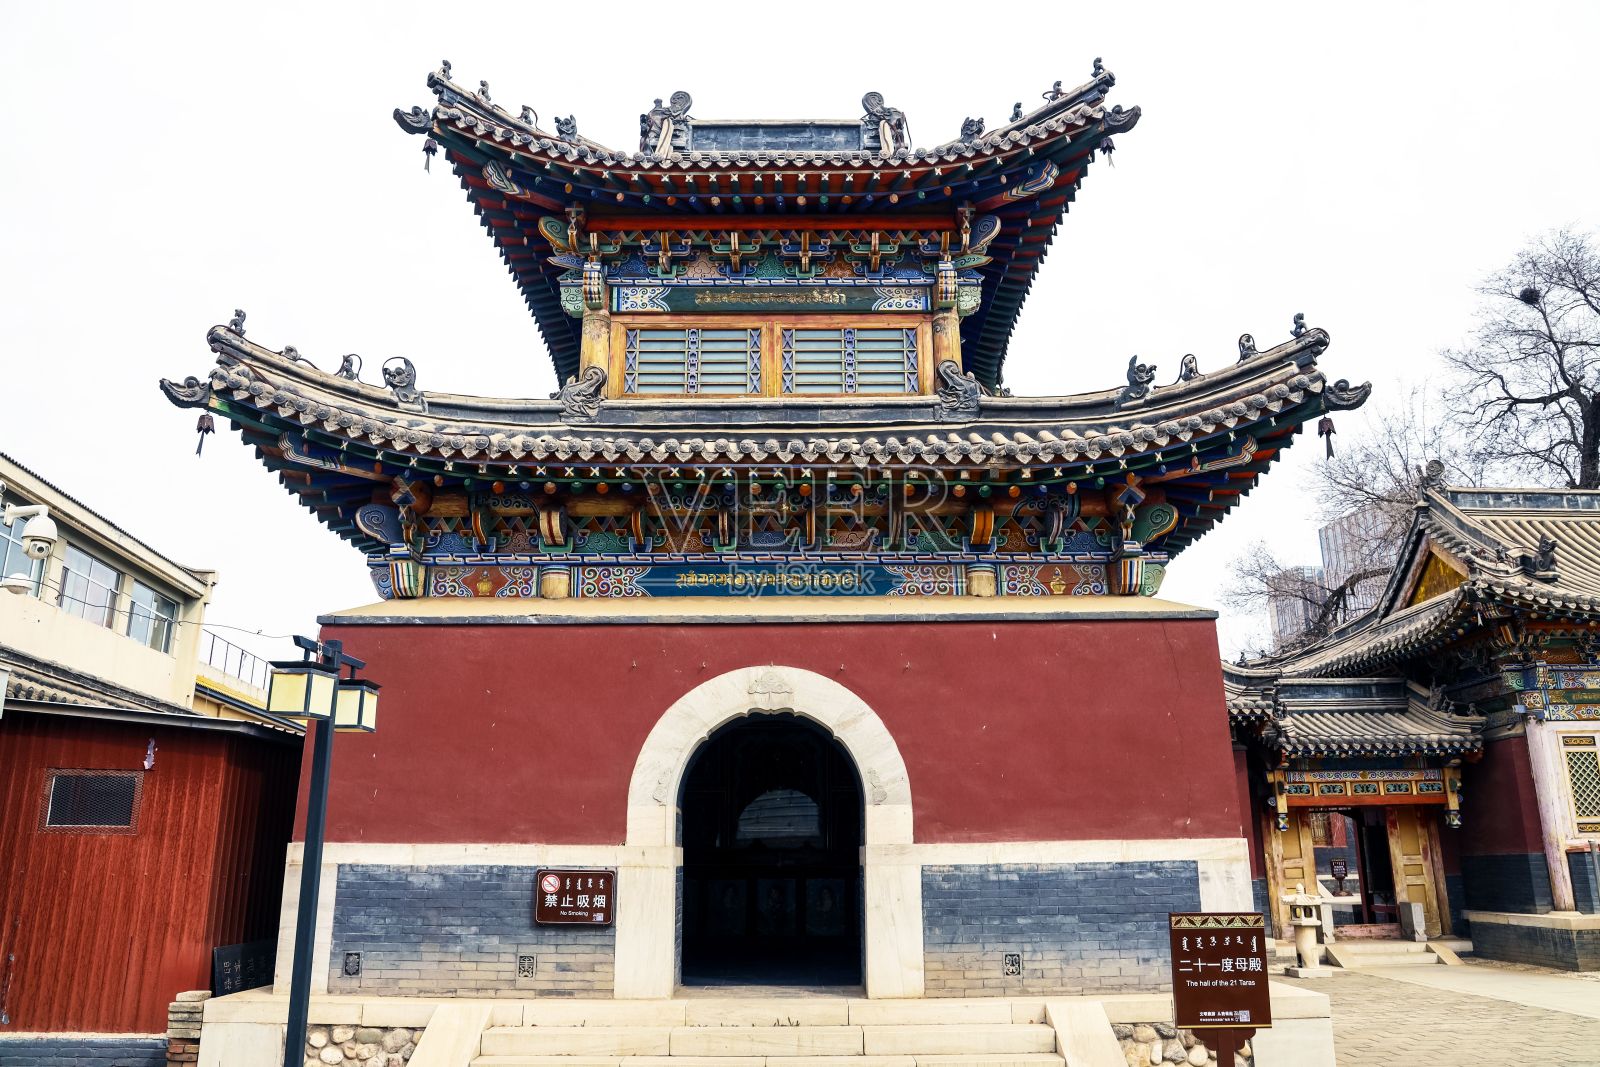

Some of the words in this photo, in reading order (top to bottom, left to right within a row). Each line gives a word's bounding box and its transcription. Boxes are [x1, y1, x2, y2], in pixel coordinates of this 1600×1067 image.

[544, 893, 606, 908] 禁止吸烟
[1179, 957, 1263, 973] 二十一度母殿
[1211, 979, 1218, 987] of
[1218, 979, 1229, 987] the
